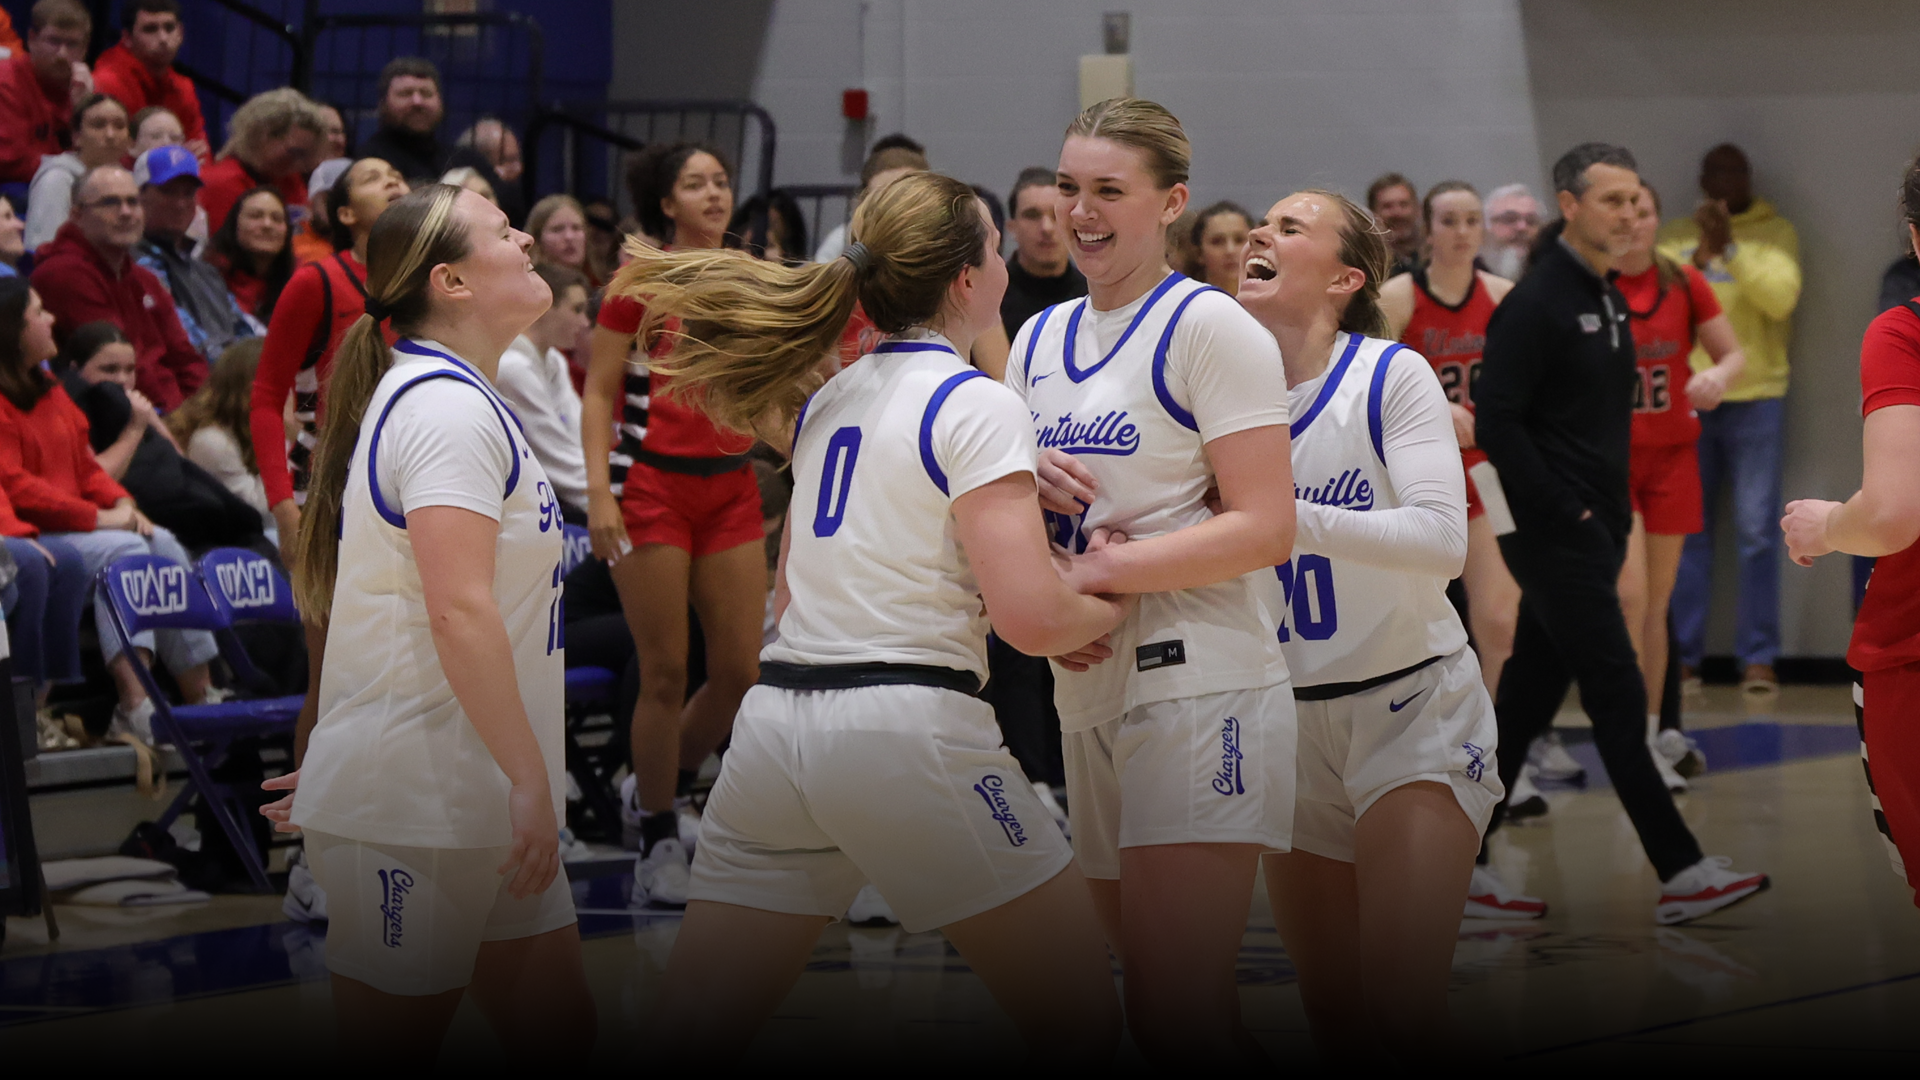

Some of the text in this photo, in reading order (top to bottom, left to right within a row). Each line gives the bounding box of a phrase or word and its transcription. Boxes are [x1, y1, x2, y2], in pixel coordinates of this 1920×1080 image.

[1031, 410, 1140, 456] ntsville
[813, 426, 862, 538] 0
[1294, 468, 1374, 512] ville
[120, 562, 187, 615] UAH
[215, 557, 275, 608] UAH
[1168, 647, 1178, 658] M
[1212, 716, 1245, 796] Chargers
[974, 775, 1028, 847] Chargers
[378, 869, 414, 948] Chargers
